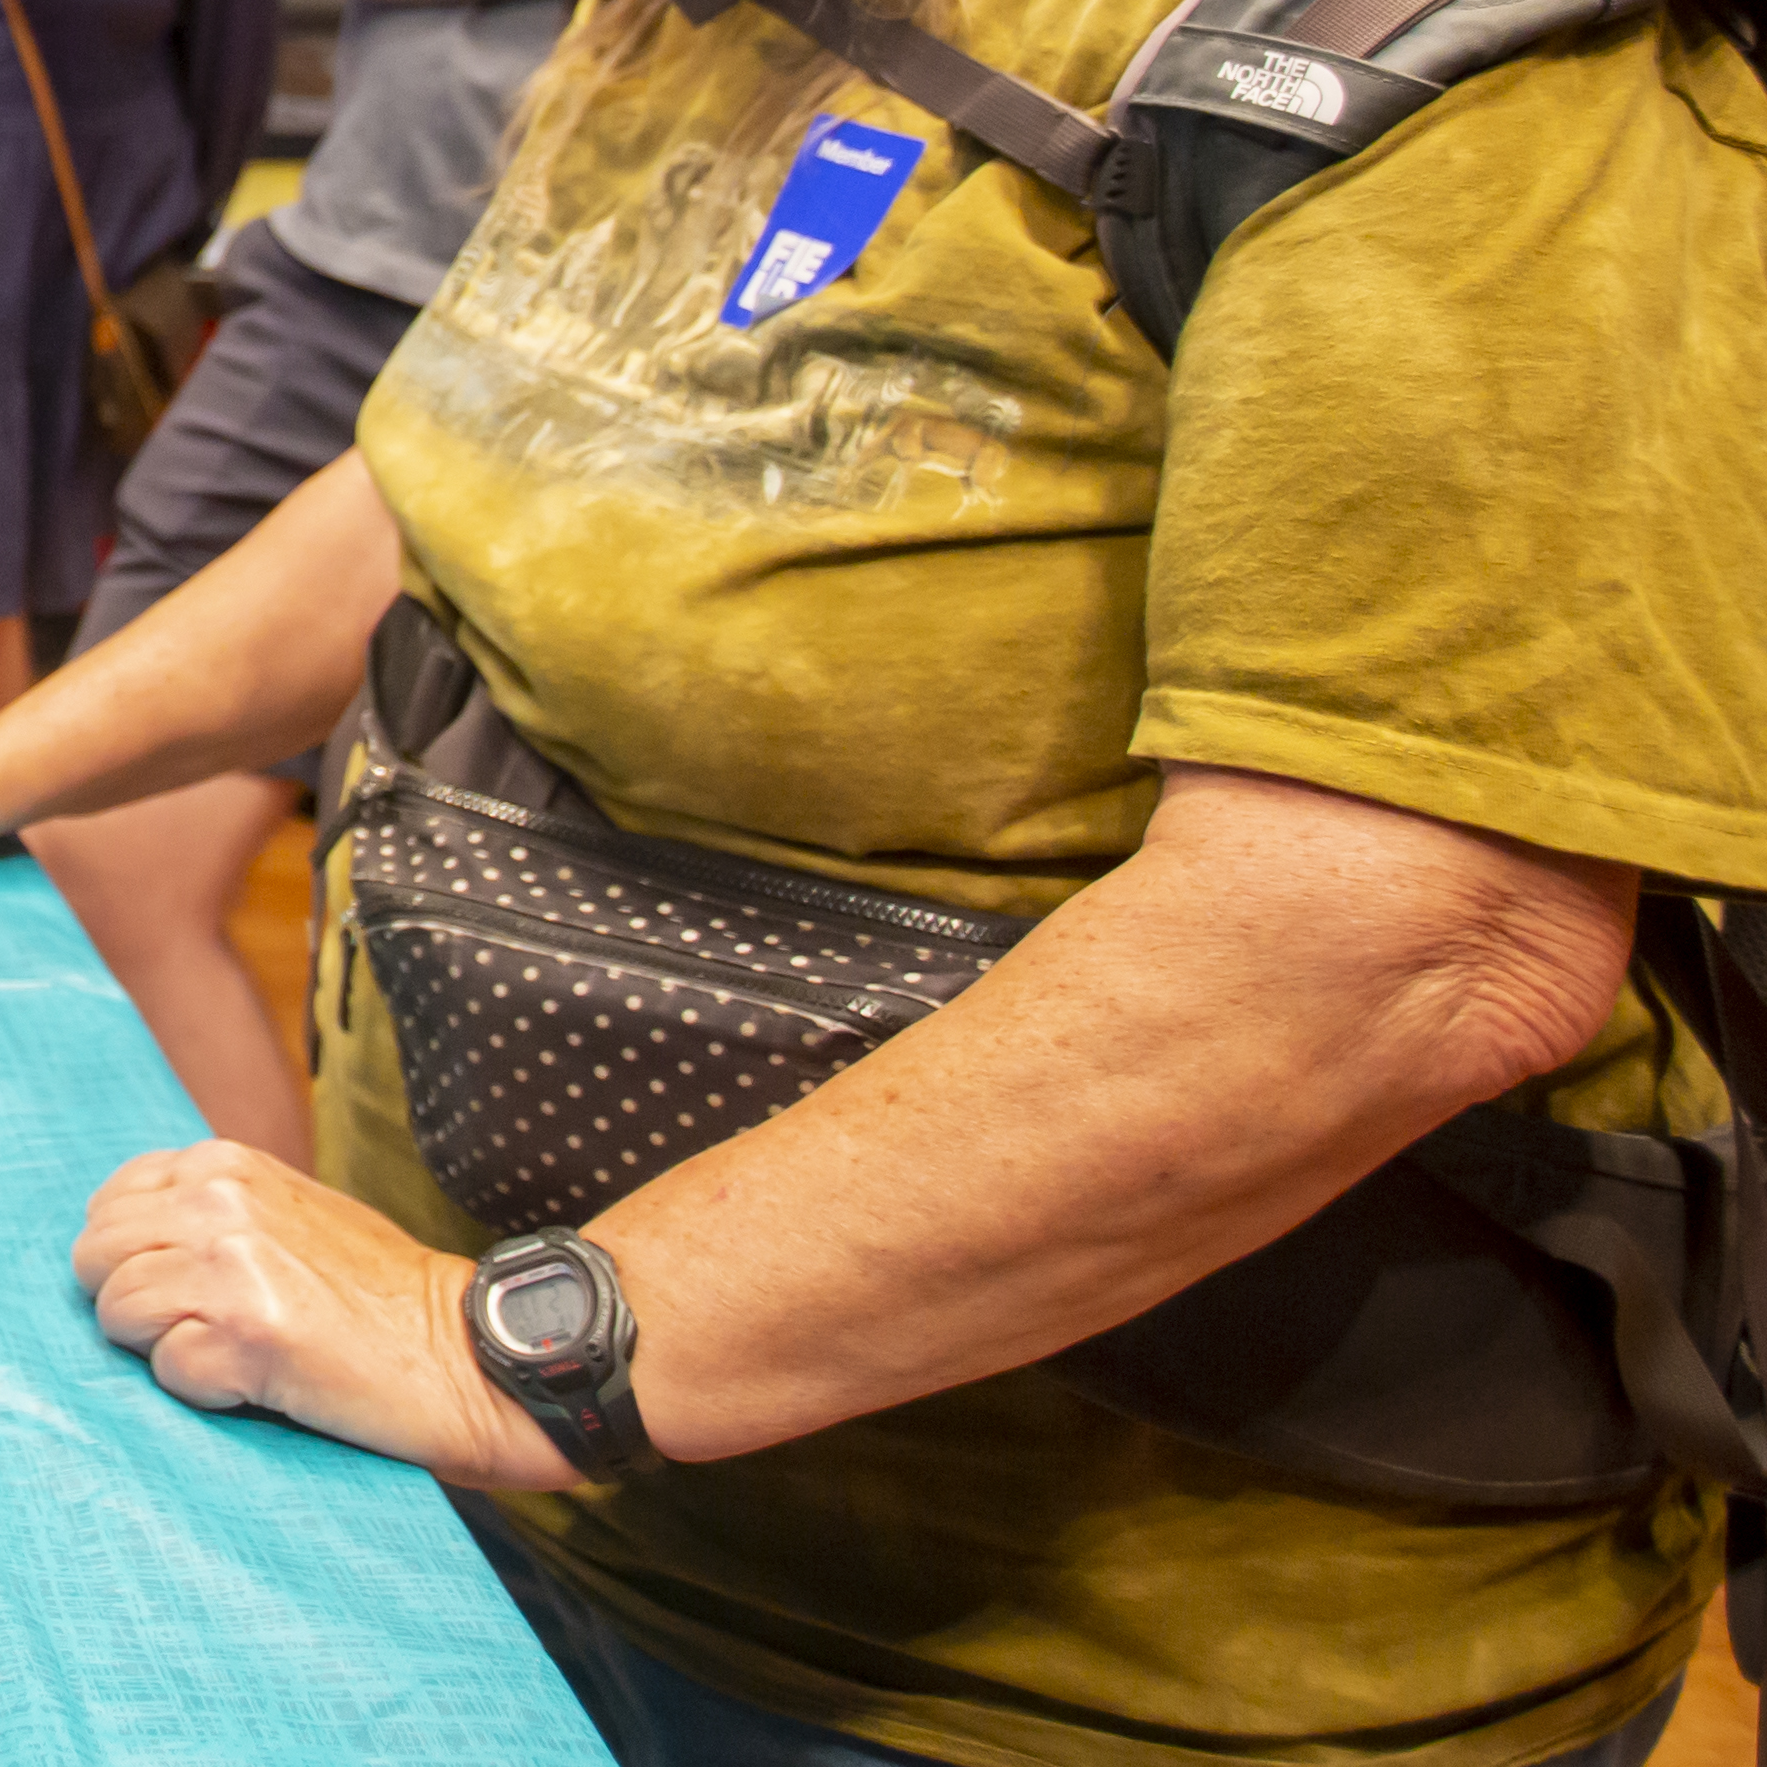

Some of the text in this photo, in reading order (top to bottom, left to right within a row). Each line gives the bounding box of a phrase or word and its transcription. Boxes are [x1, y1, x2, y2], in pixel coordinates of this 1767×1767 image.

[1217, 61, 1303, 93] NORTH
[1264, 51, 1309, 77] THE
[1230, 84, 1293, 110] FACE
